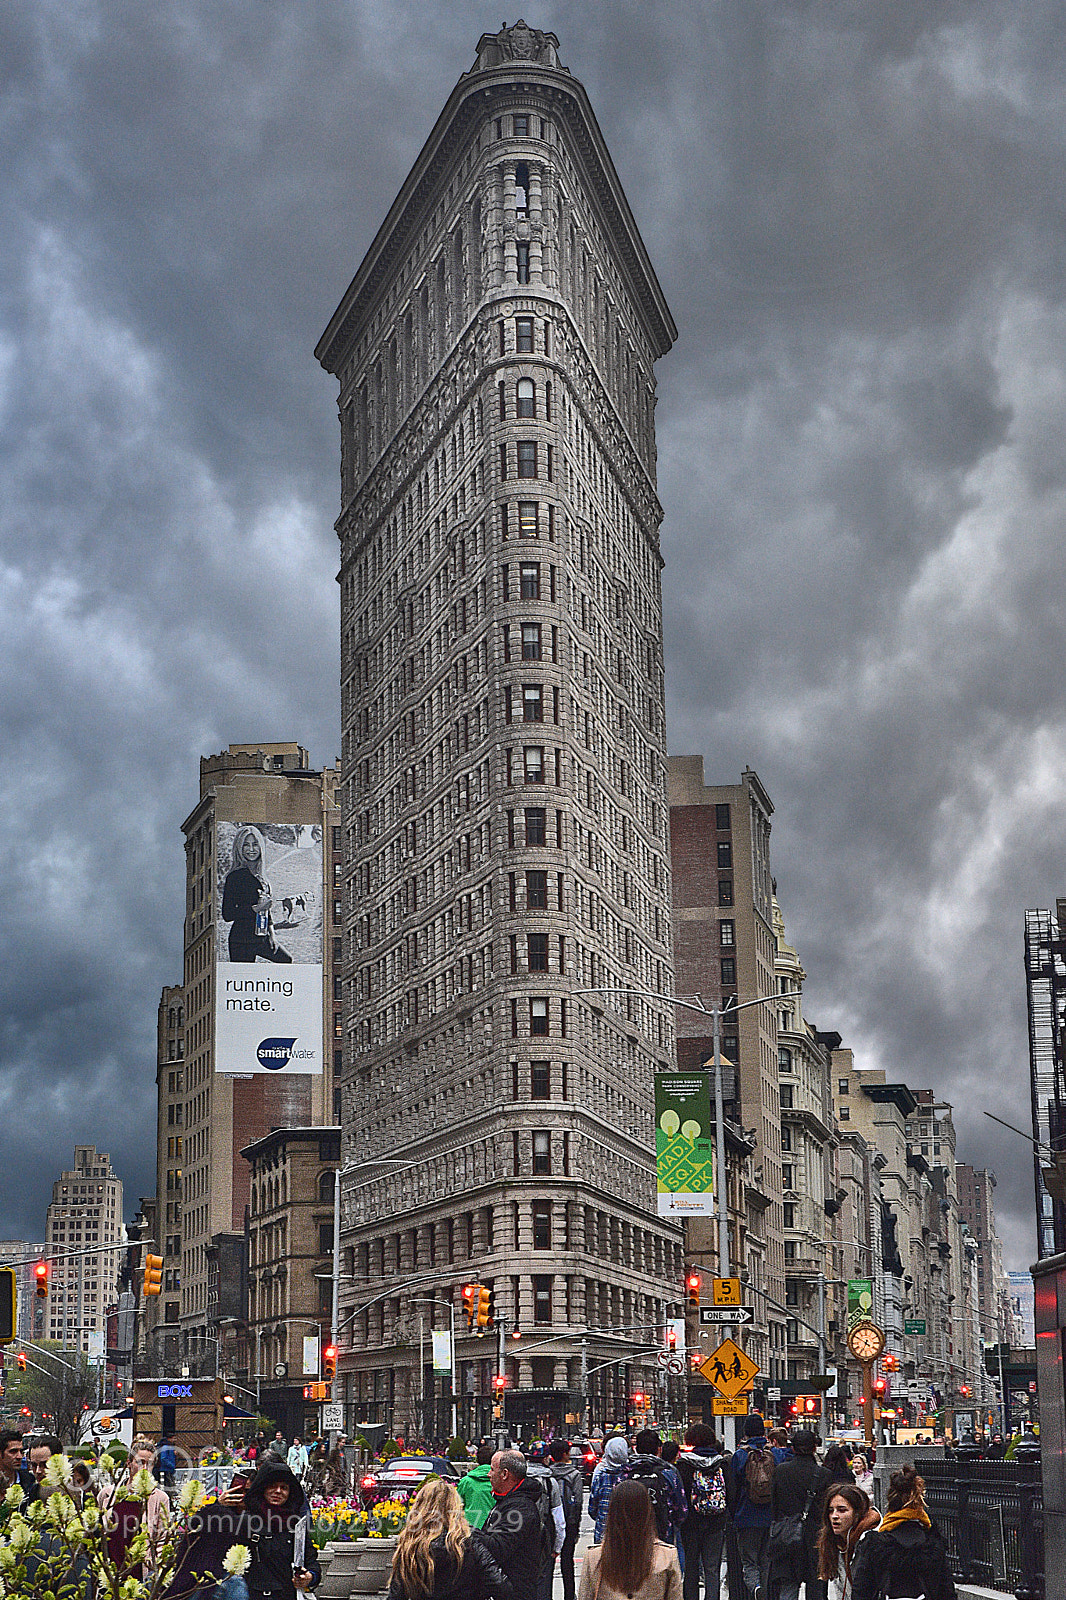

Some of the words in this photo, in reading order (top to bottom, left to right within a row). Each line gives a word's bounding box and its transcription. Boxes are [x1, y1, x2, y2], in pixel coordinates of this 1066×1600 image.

[226, 977, 293, 997] running
[226, 997, 276, 1012] mate.
[721, 1281, 732, 1295] 5
[707, 1312, 724, 1320] ONE
[730, 1312, 746, 1320] WAY
[157, 1384, 193, 1398] BOX
